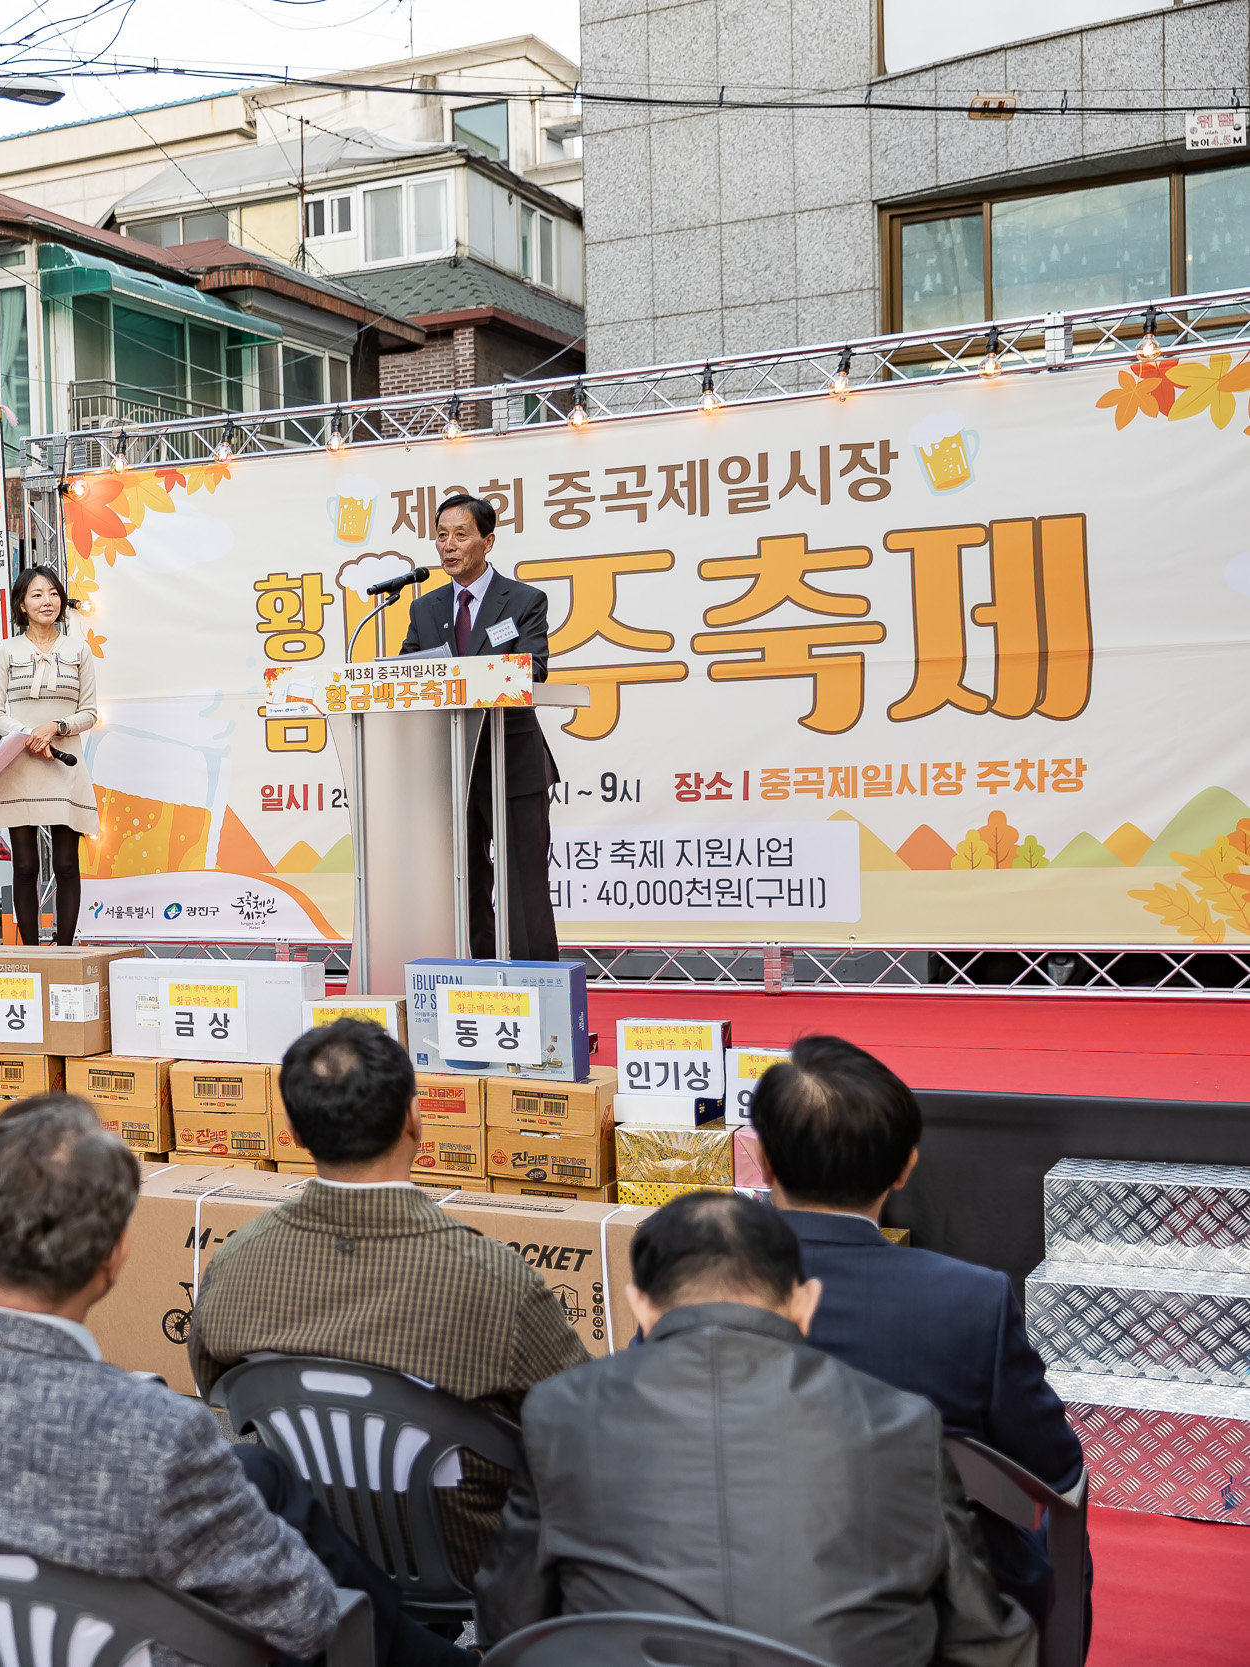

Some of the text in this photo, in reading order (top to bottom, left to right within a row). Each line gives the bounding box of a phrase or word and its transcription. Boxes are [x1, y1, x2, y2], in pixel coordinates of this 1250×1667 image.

[391, 439, 899, 541] 제회 중곡제일시장
[344, 664, 447, 682] 제3회 중곡제일시장
[325, 679, 467, 712] 황금맥주축제
[759, 761, 967, 801] 중곡제일시장
[976, 757, 1088, 796] 주차장
[609, 839, 664, 869] 축제
[675, 837, 793, 868] 지원사업
[105, 905, 154, 919] 서울특별시
[185, 906, 220, 917] 광진구
[10, 989, 27, 999] 축제
[176, 996, 230, 1007] 황금맥주 축제
[454, 990, 522, 1002] 제3회 중곡제일시장
[456, 1003, 521, 1016] 황금맥주 축제
[631, 1025, 704, 1035] 제3회 중곡제일시장
[634, 1038, 703, 1050] 황금맥주 축제
[746, 1055, 768, 1063] 제3회
[626, 1061, 711, 1091] 인기상
[195, 1128, 228, 1146] 진라면
[510, 1151, 549, 1169] 진라면
[497, 1241, 593, 1272] CKET
